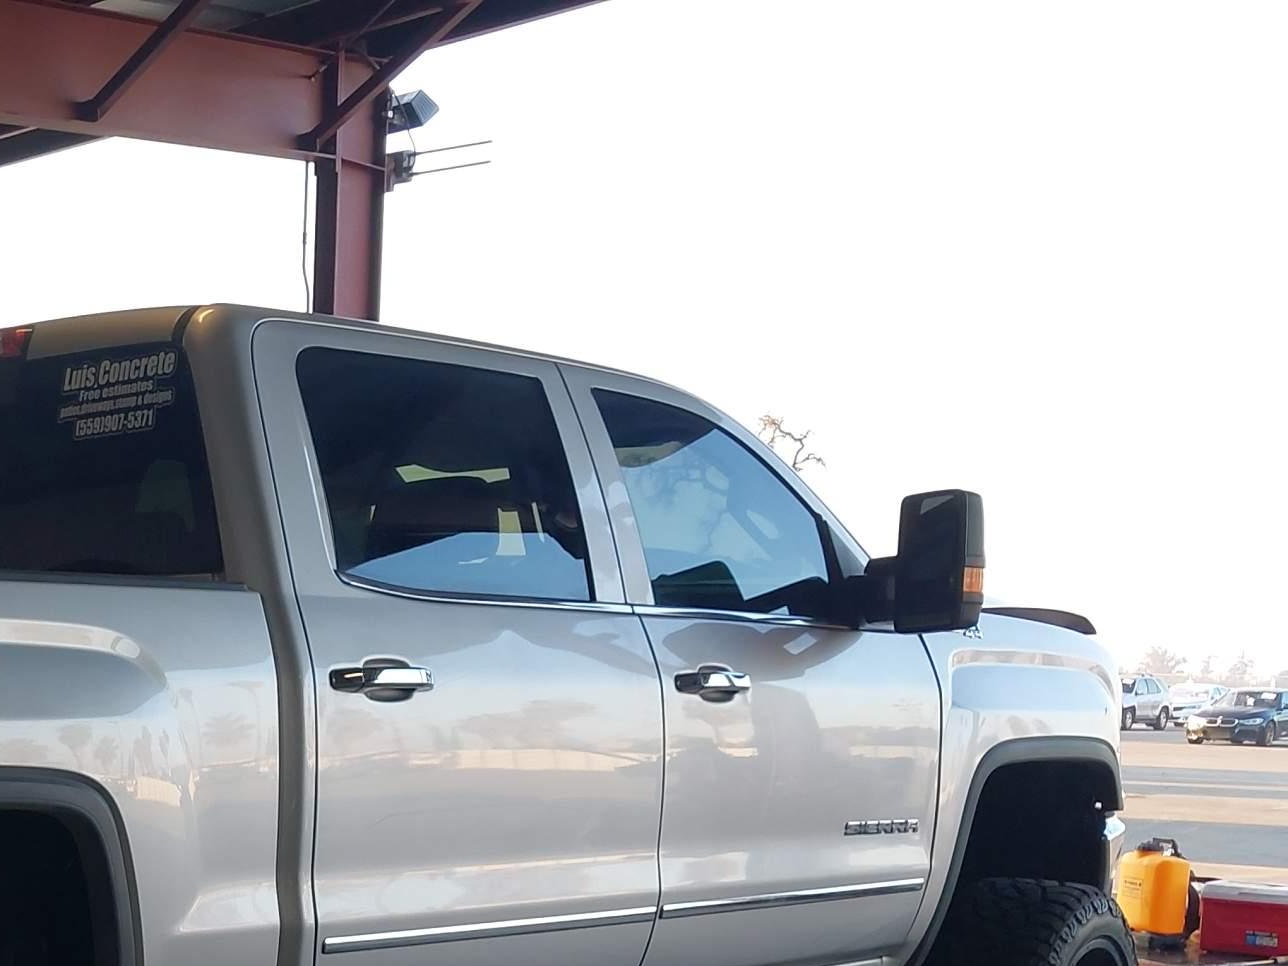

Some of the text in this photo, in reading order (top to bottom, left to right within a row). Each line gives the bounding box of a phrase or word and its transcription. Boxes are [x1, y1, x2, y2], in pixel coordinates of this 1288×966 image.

[98, 351, 176, 386] Concrete
[78, 380, 154, 402] Free estimates
[75, 408, 153, 437] (559)907-5371
[843, 818, 920, 836] SIERRA
